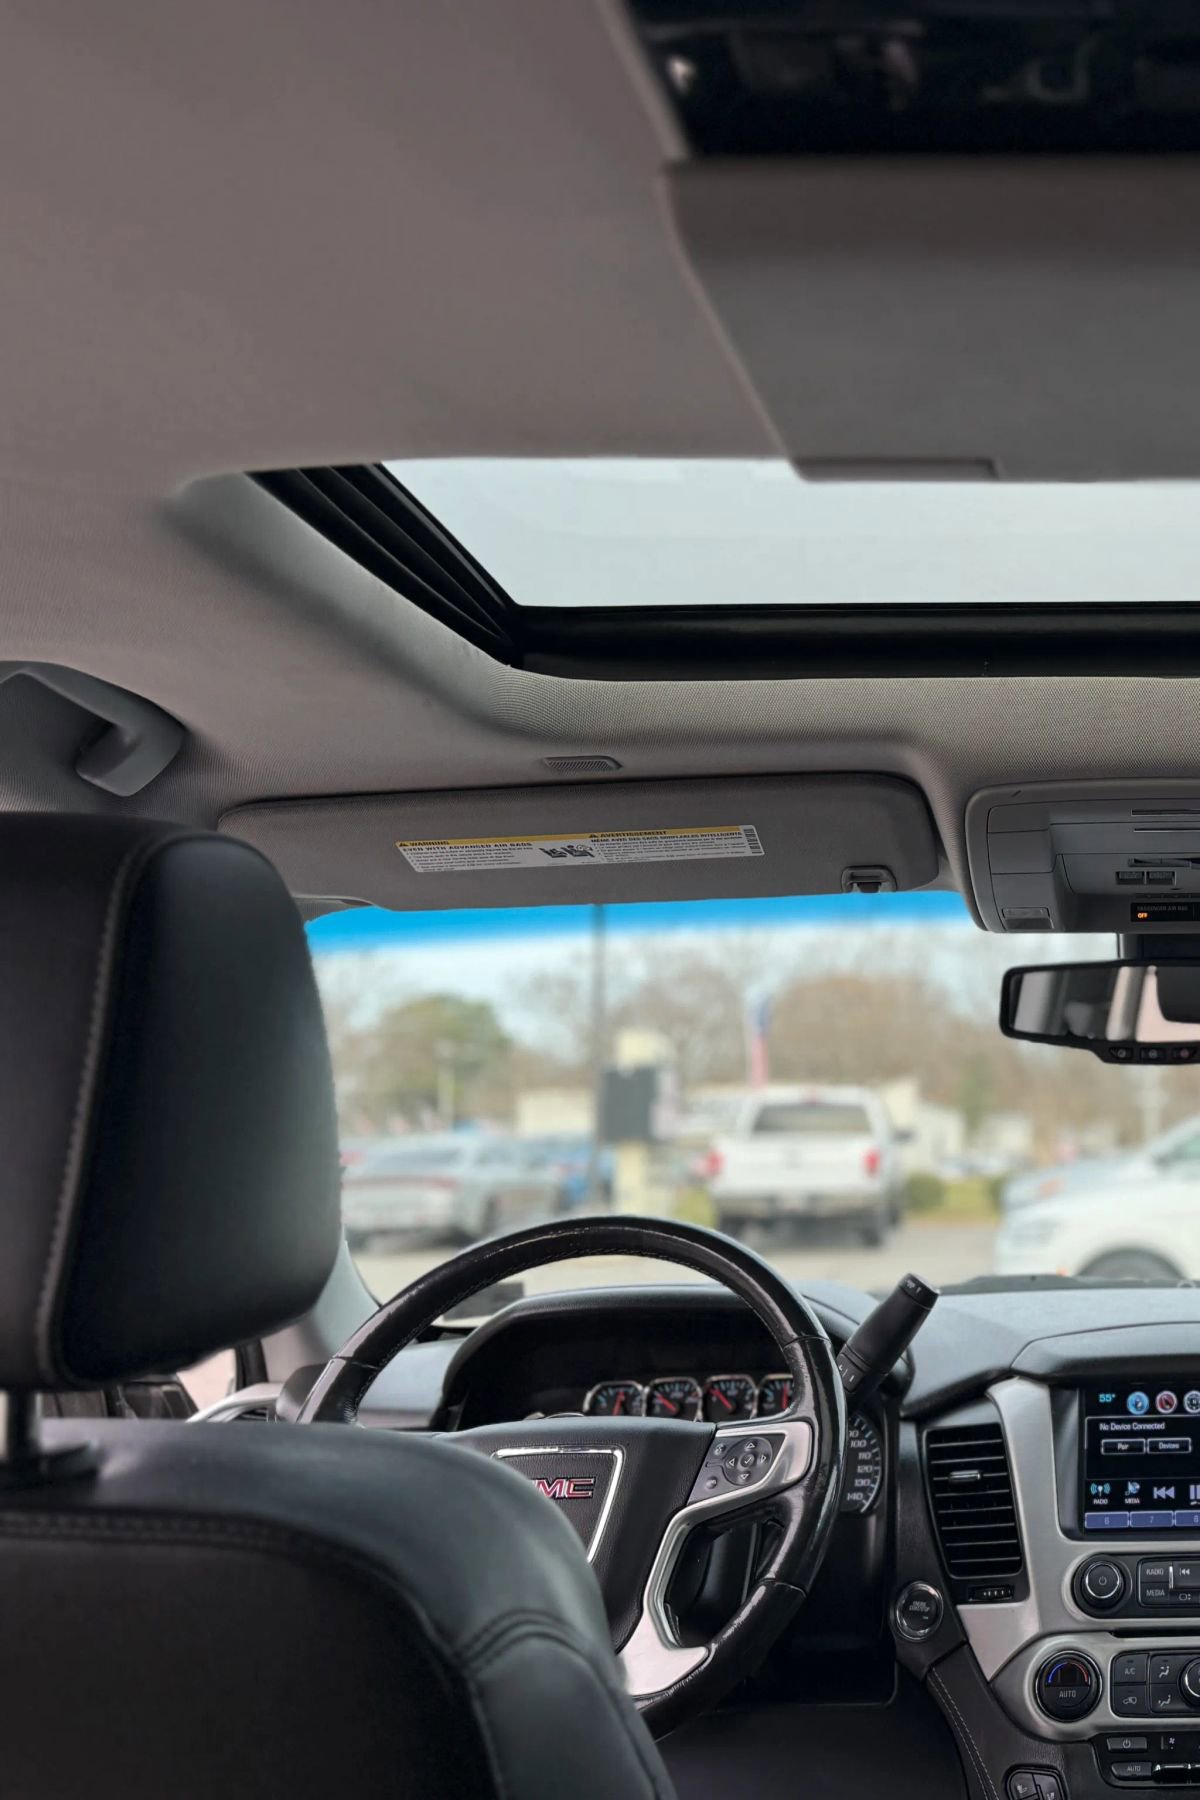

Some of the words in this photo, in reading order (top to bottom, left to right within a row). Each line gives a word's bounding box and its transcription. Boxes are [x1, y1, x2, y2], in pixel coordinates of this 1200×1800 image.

[1099, 1422, 1110, 1431] No
[1111, 1422, 1132, 1431] Device
[1132, 1421, 1165, 1431] Connected
[850, 1440, 867, 1448] 100
[1158, 1441, 1180, 1450] Devices
[858, 1452, 872, 1460] 110
[857, 1465, 873, 1473] 120
[854, 1479, 871, 1487] 130
[532, 1478, 595, 1499] MC
[847, 1493, 863, 1501] 140
[1146, 1567, 1164, 1575] RADIO
[1146, 1589, 1165, 1597] MEDIA
[1125, 1667, 1136, 1676] A/C
[1059, 1690, 1077, 1698] AUTO
